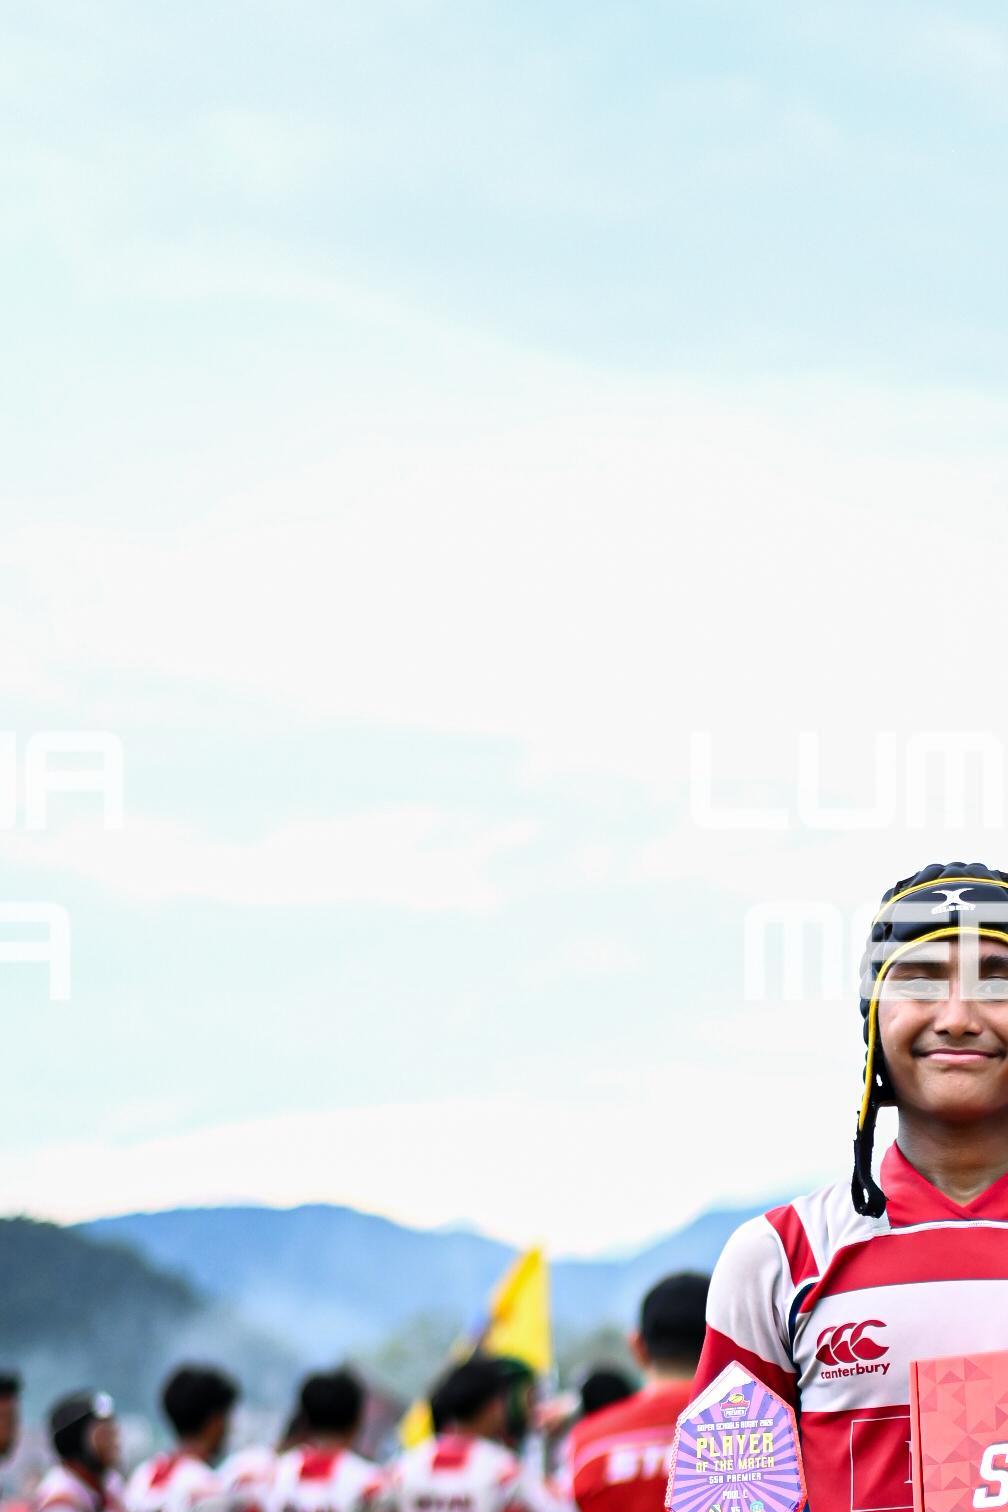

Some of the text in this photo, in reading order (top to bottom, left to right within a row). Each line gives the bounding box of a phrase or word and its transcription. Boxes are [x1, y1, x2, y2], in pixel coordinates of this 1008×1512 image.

[821, 1363, 890, 1379] canterbury
[697, 1433, 774, 1458] PLAYER
[696, 1457, 774, 1472] OF THE MATCH
[727, 1473, 761, 1482] PREMIER
[723, 1490, 739, 1499] POOL
